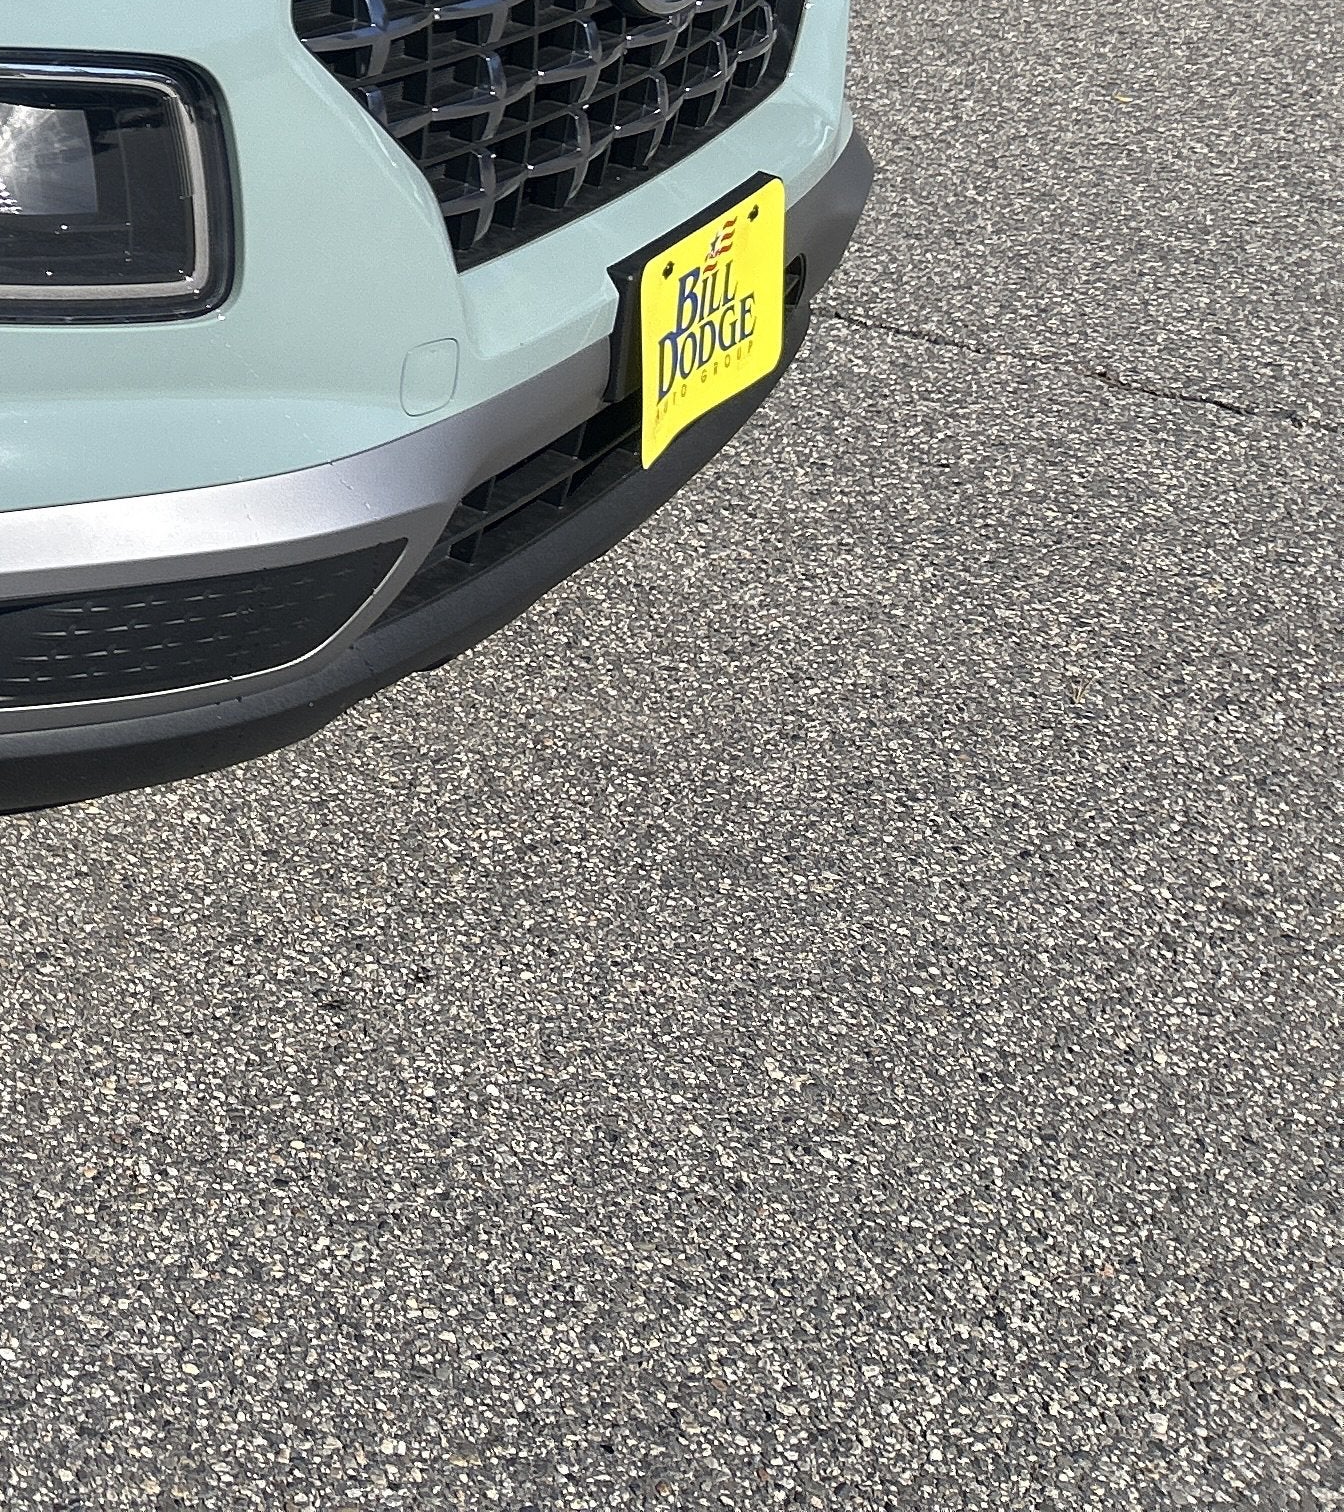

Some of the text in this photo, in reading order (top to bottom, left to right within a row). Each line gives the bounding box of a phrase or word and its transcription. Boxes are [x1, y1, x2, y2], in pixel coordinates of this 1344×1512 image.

[675, 259, 739, 338] BILL
[655, 340, 754, 425] AUTO GROUP
[656, 290, 758, 405] DODGE
